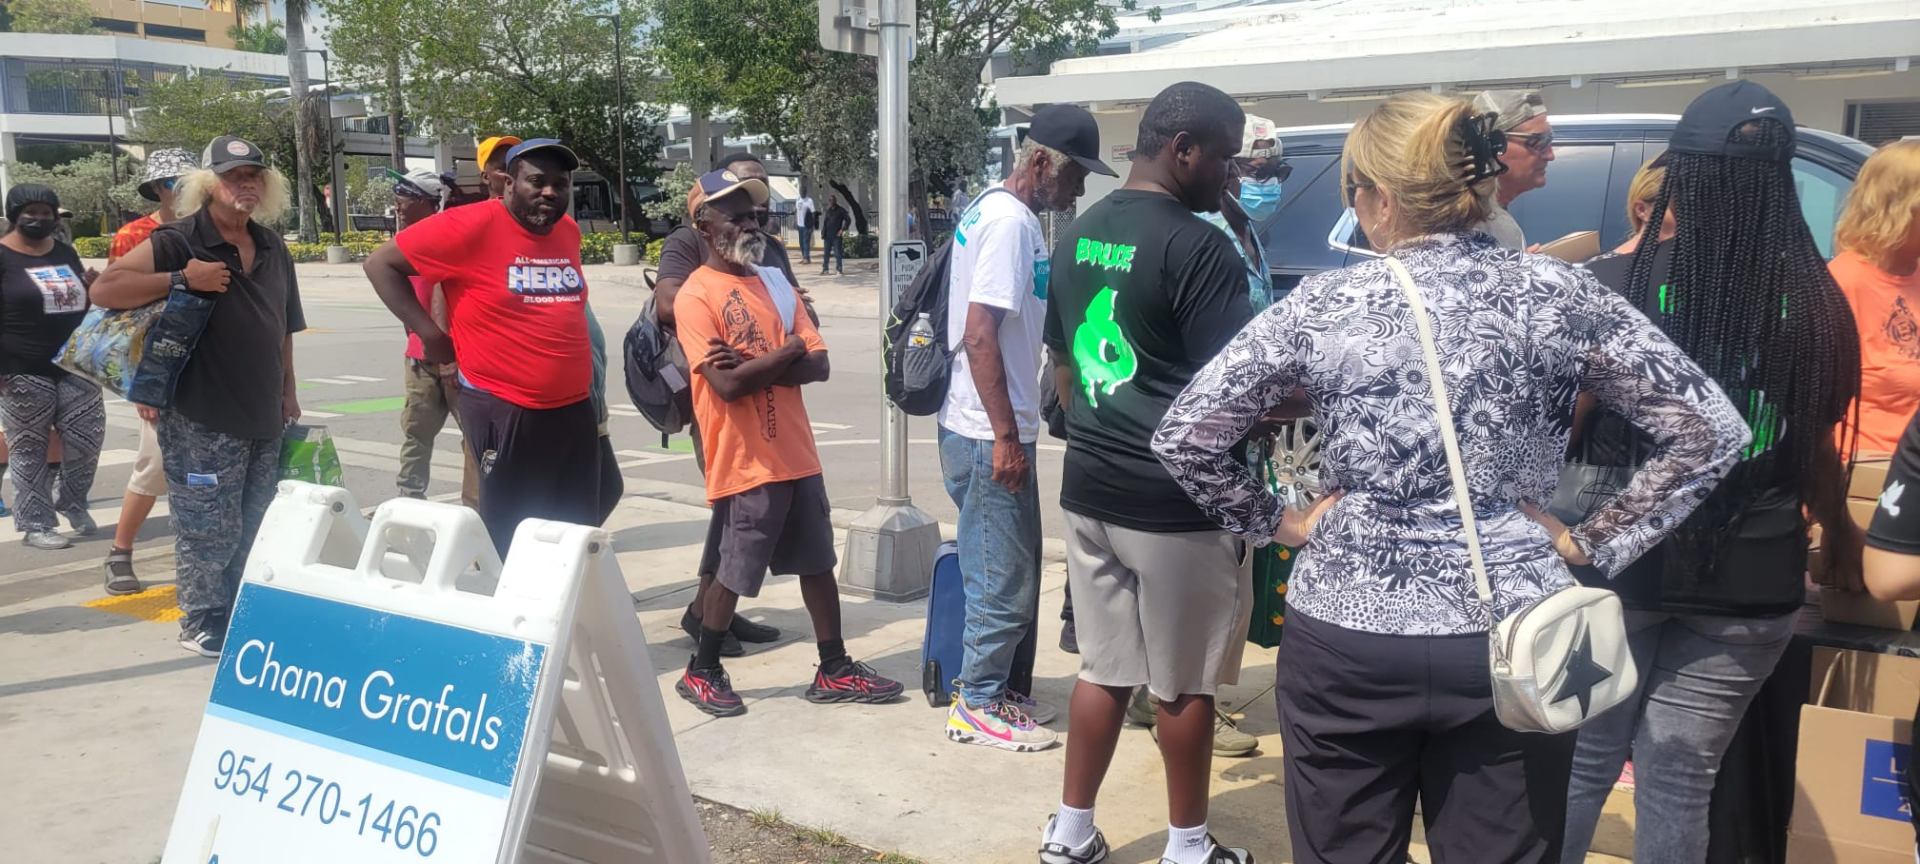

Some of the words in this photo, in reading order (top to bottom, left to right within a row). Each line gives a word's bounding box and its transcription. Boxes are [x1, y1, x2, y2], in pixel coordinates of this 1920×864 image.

[1076, 238, 1137, 272] BRUCE
[508, 265, 582, 292] HERO
[523, 295, 555, 303] BLOOD
[766, 386, 777, 438] OATS
[235, 639, 347, 709] Chana
[359, 670, 503, 750] Grafals
[214, 750, 272, 802] 954
[277, 769, 441, 857] 270-1466
